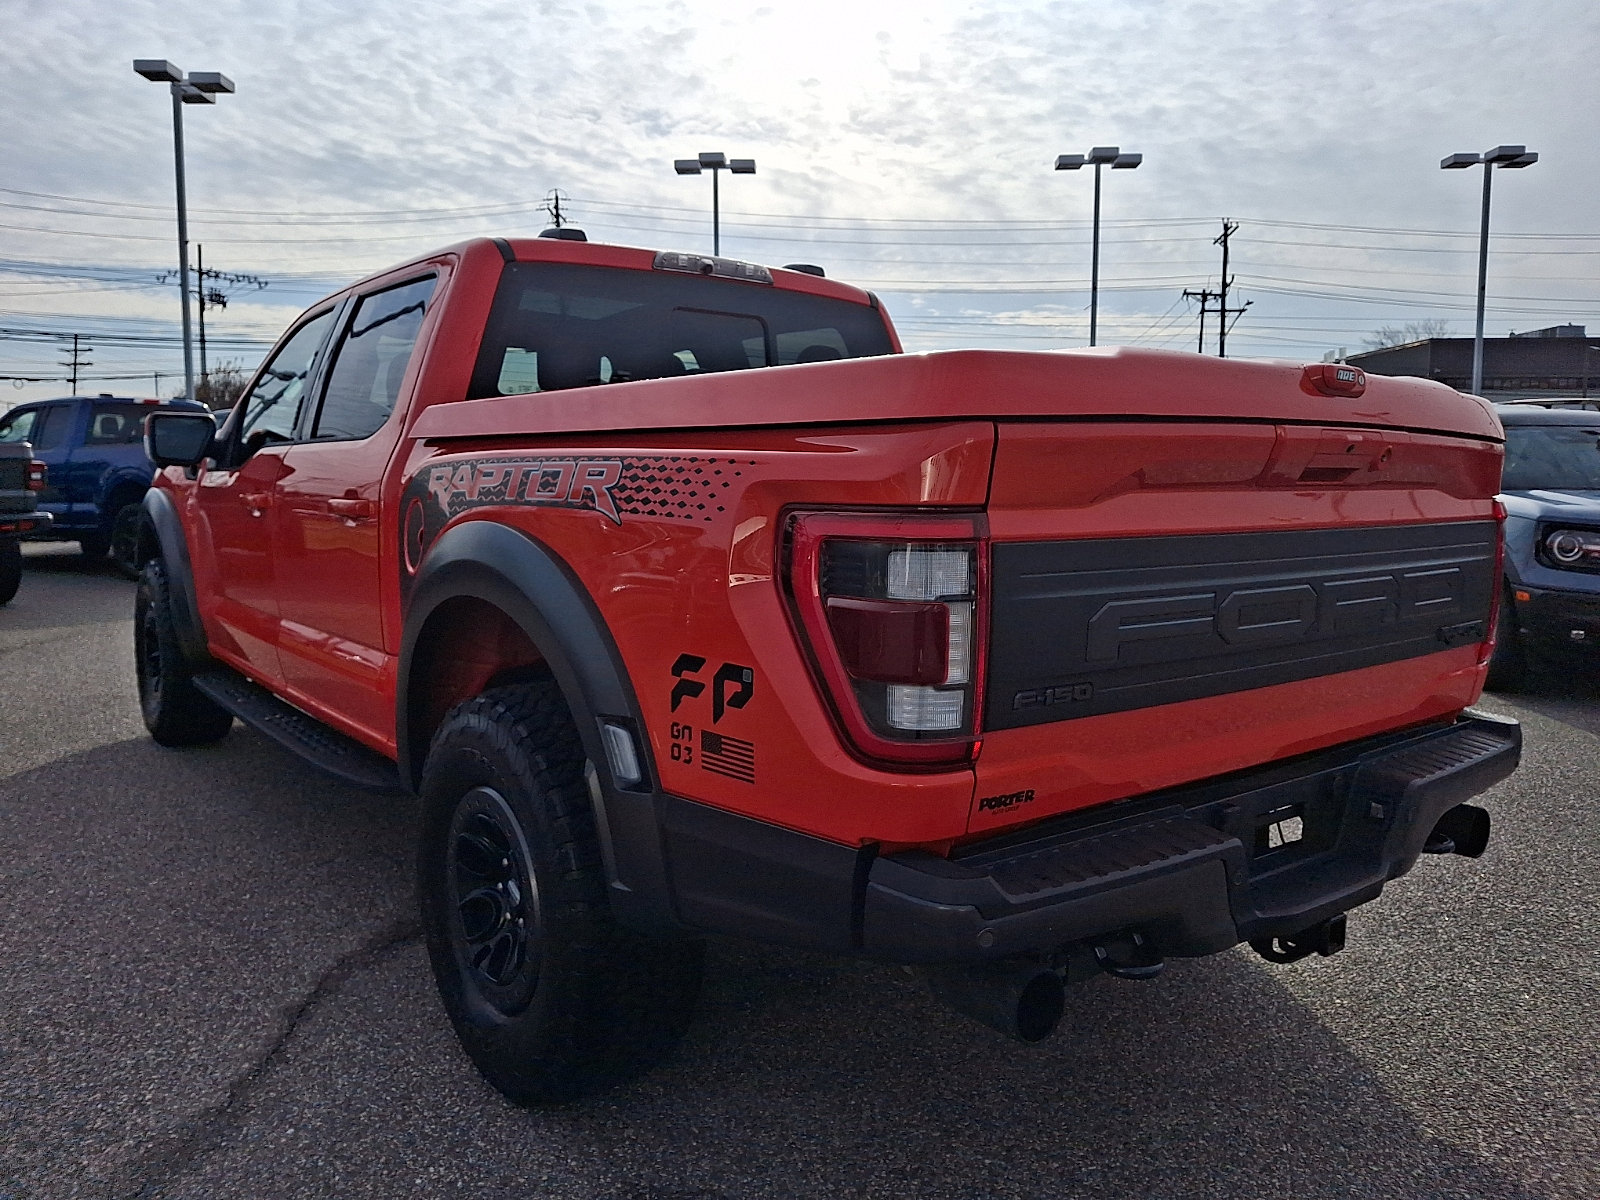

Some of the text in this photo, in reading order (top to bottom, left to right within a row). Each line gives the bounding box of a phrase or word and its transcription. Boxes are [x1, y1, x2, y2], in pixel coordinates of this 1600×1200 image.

[428, 461, 624, 524] RAPTOR
[1085, 568, 1462, 662] FORD
[1012, 682, 1094, 710] F-150
[671, 743, 692, 764] 03
[979, 789, 1034, 812] PORTER
